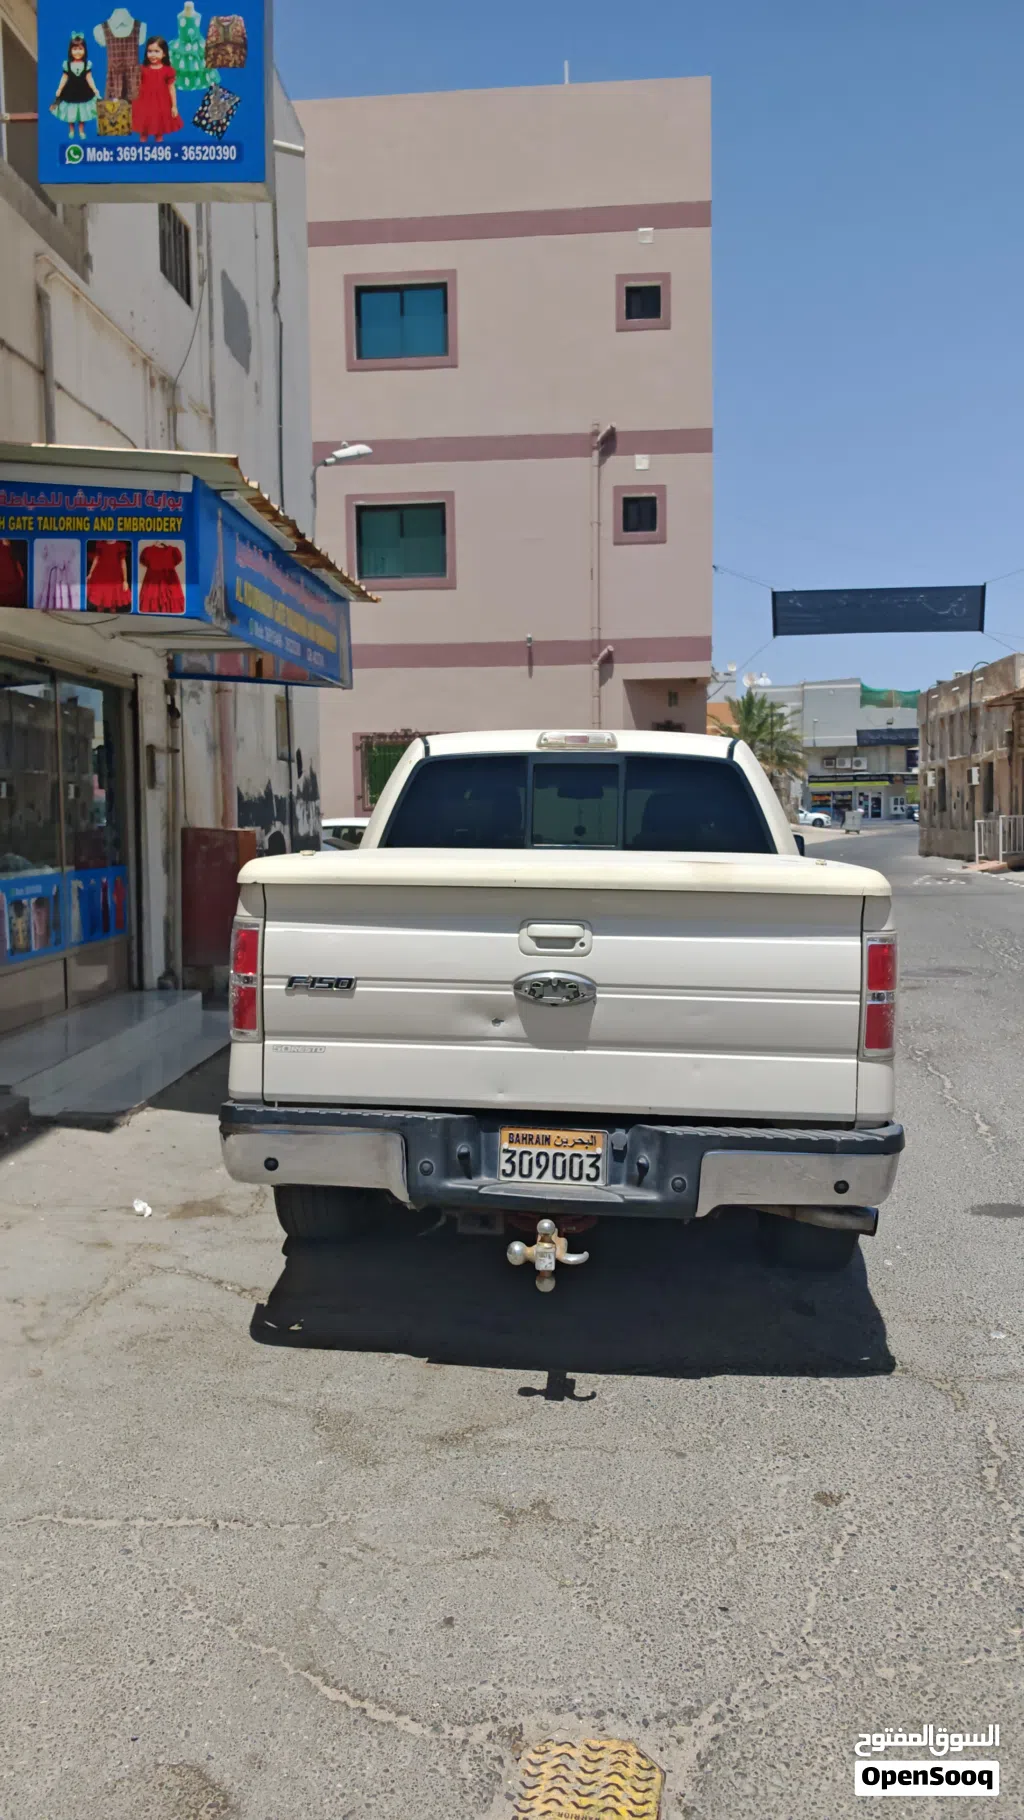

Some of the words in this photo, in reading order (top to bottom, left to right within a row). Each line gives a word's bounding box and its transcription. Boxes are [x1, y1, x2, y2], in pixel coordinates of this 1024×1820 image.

[86, 147, 114, 162] Mob:
[116, 146, 171, 161] 36915496
[181, 145, 237, 161] 36520390
[65, 488, 142, 511] الكورنيش
[145, 490, 184, 512] بوابة
[8, 515, 34, 531] GATE
[37, 516, 91, 531] TAILORING
[93, 516, 114, 532] AND
[117, 517, 183, 532] EMBROIDERY
[508, 1133, 551, 1146] BAHRAIN
[553, 1134, 597, 1149] البحرين
[501, 1148, 602, 1182] 309003
